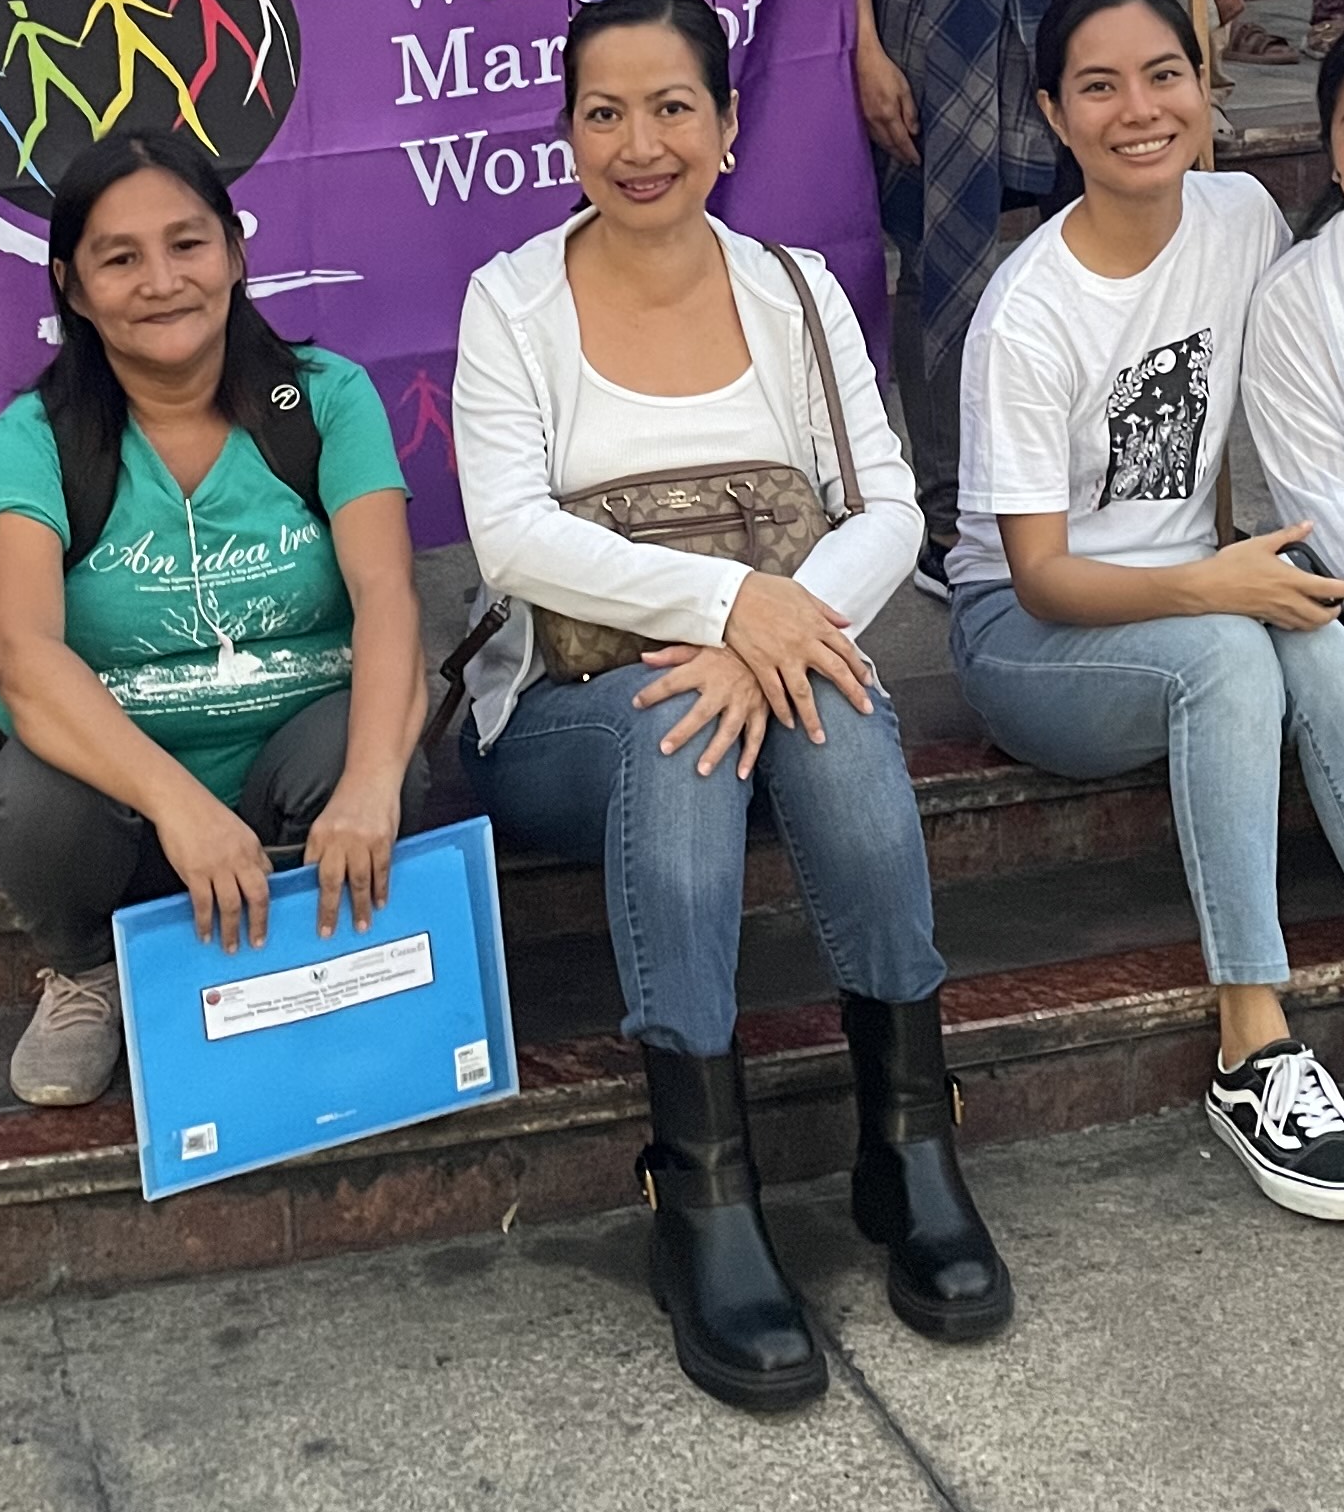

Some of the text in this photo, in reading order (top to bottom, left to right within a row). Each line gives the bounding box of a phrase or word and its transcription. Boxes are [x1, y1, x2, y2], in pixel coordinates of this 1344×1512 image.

[391, 26, 566, 106] Mar
[89, 529, 179, 575] An
[191, 533, 270, 573] idea
